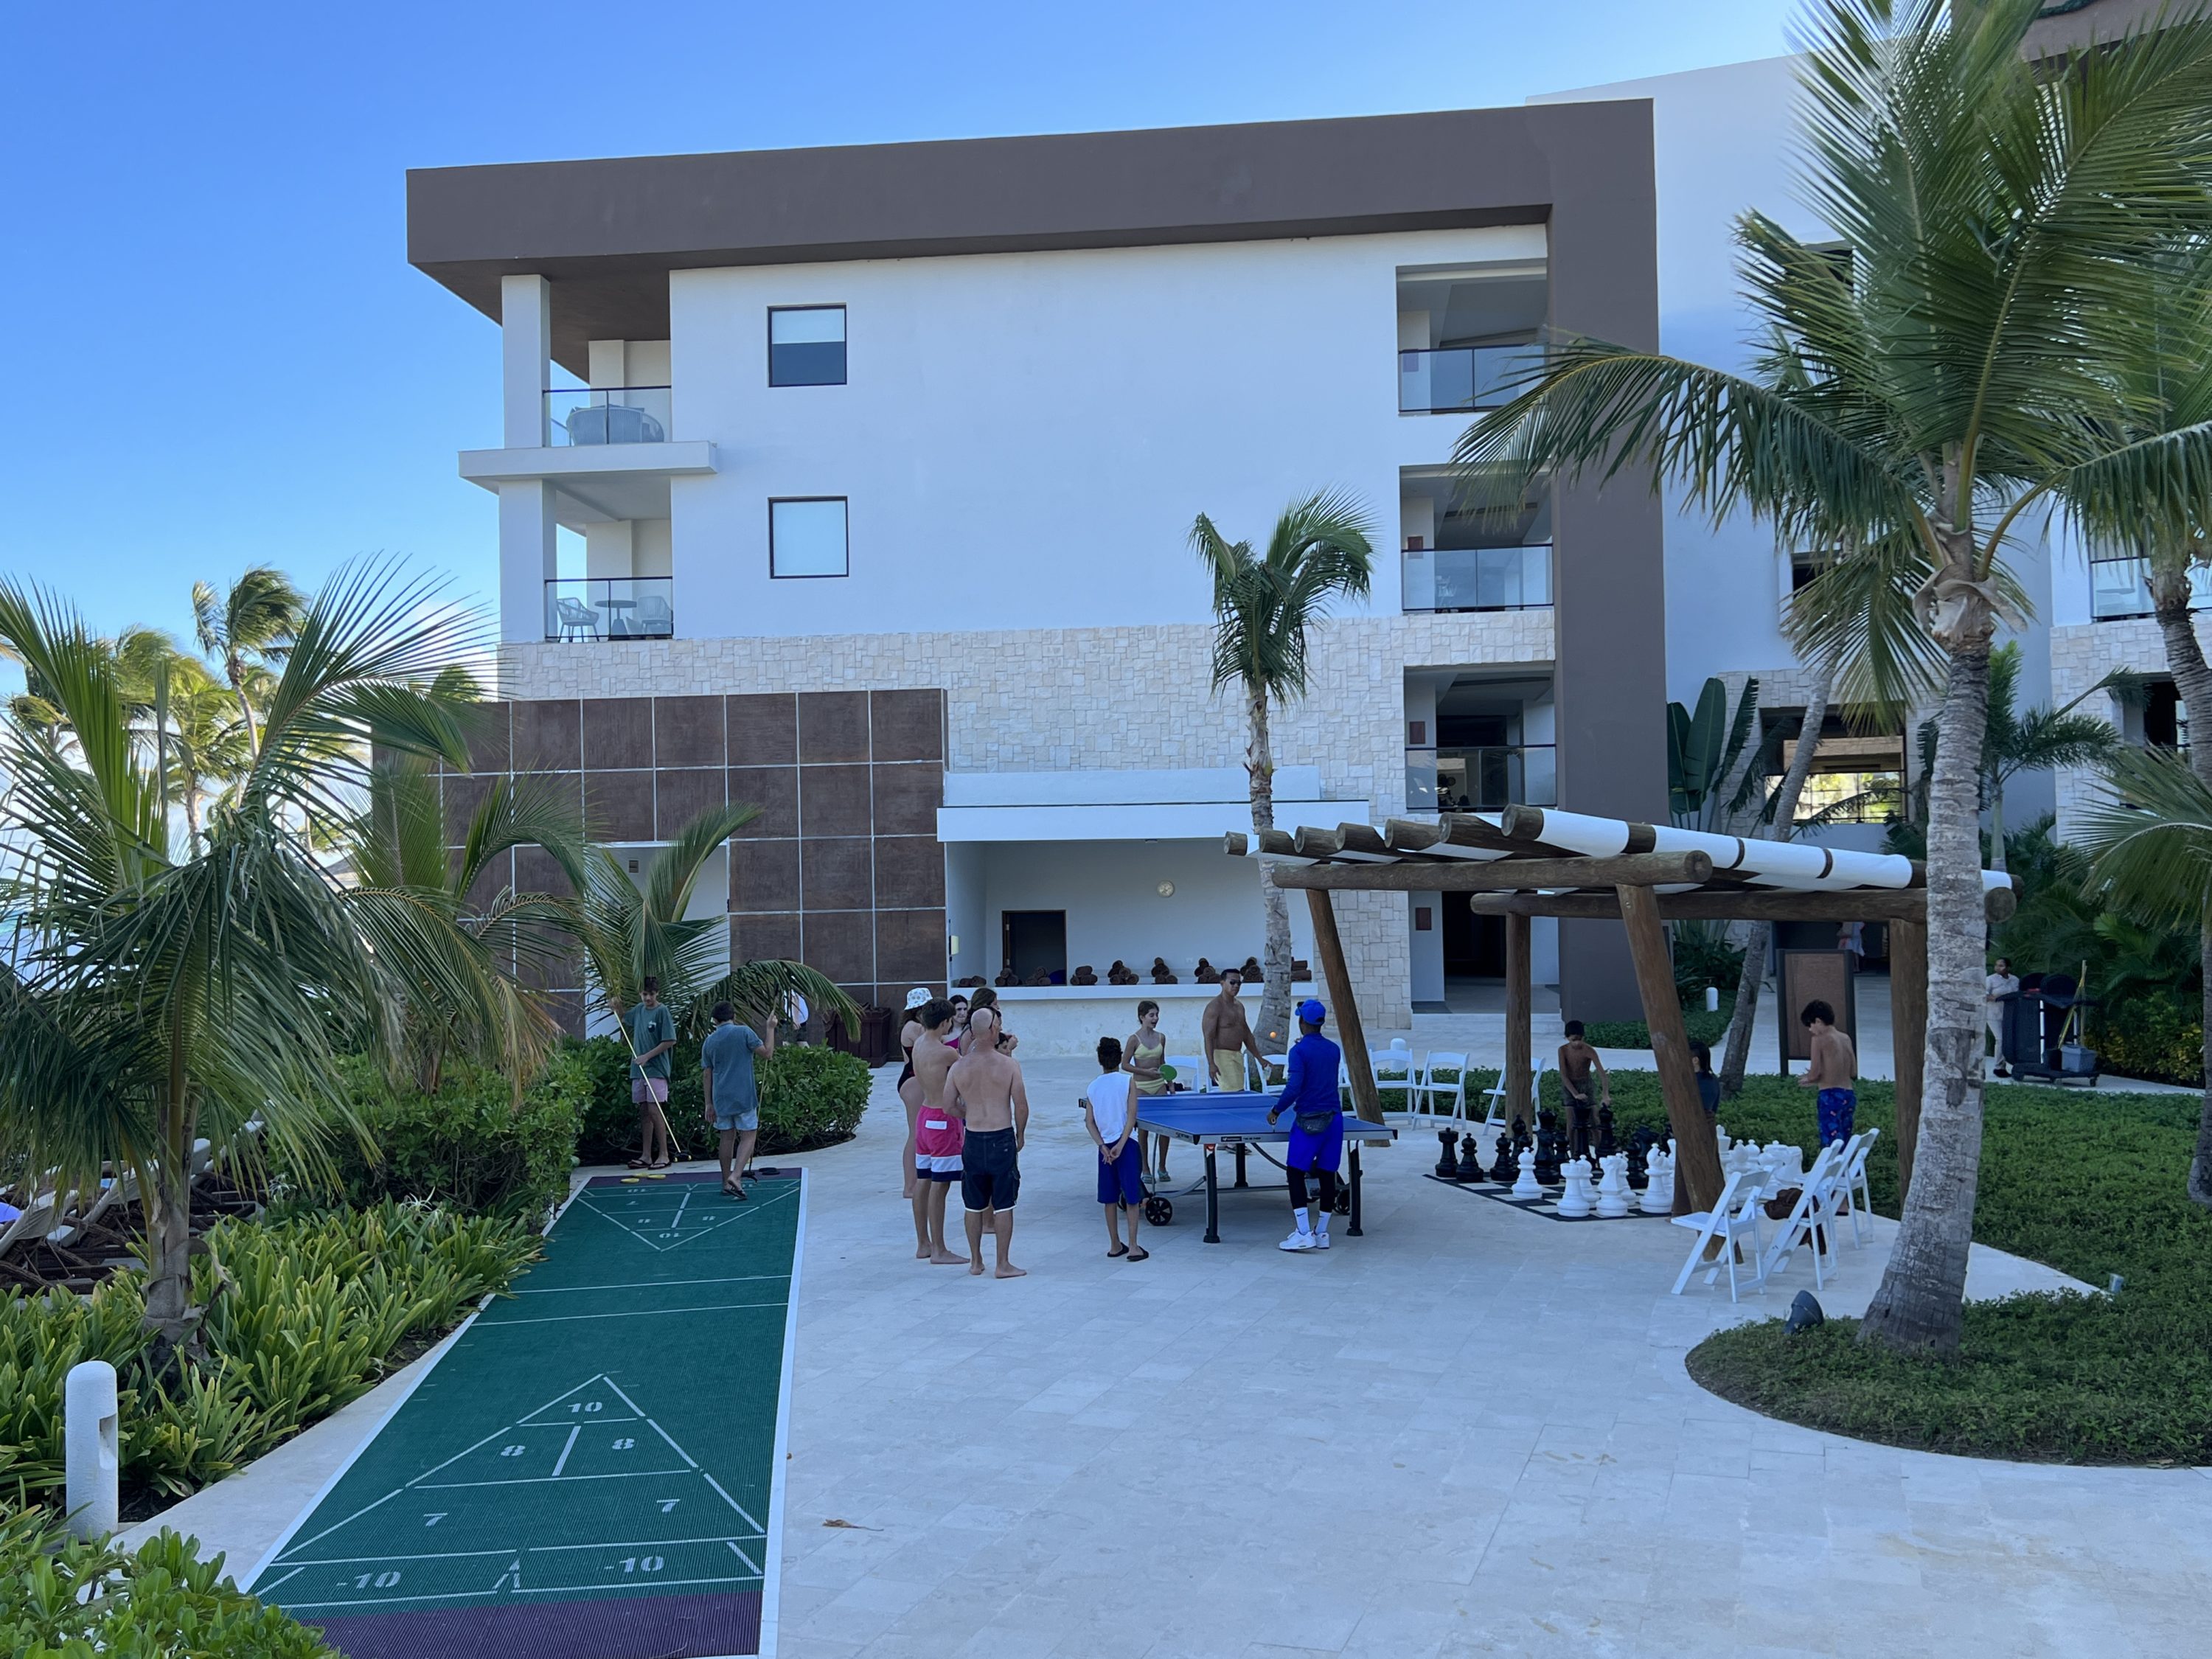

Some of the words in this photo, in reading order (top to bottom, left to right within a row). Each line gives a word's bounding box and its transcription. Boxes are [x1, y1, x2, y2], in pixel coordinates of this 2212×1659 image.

[567, 1401, 603, 1413] 10
[501, 1444, 526, 1456] 8
[612, 1438, 635, 1450] 8
[656, 1498, 681, 1513] 7
[423, 1512, 448, 1527] 7
[605, 1555, 665, 1573] -10
[336, 1571, 402, 1590] -10
